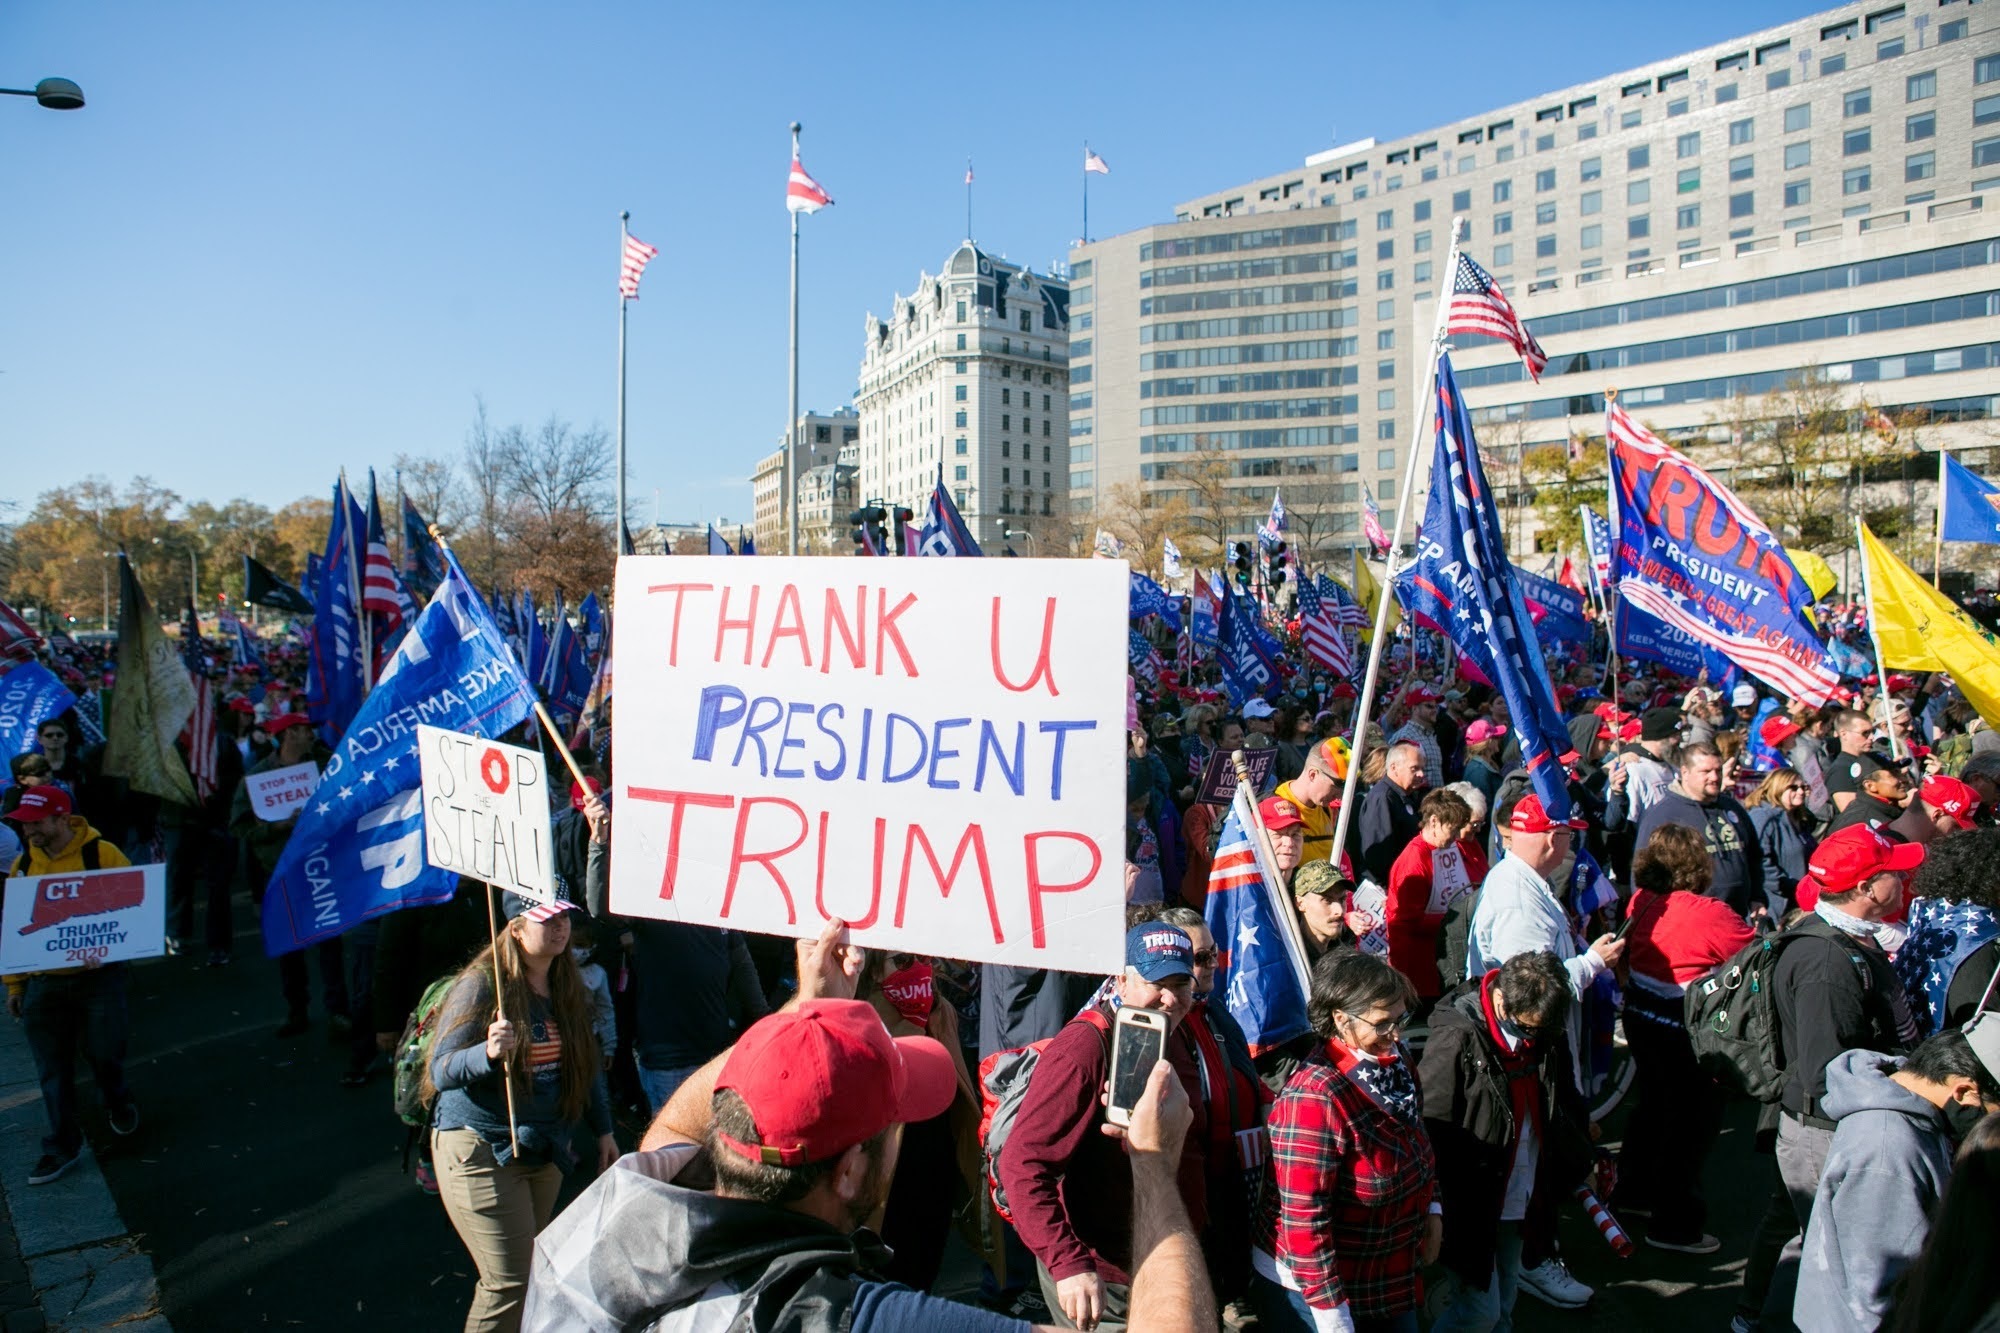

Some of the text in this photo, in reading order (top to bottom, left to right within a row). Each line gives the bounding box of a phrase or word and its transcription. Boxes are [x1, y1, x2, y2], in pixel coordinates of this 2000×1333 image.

[1652, 535, 1768, 606] PRESIDENT
[1523, 581, 1575, 613] UMP
[1620, 542, 1638, 567] AKE
[1706, 595, 1757, 633] GREAT
[1754, 624, 1824, 671] AGAIN!
[648, 583, 919, 677] THANK
[991, 596, 1059, 697] U
[1628, 633, 1655, 645] KEEP
[692, 685, 1098, 801] PRESIDENT
[1223, 757, 1270, 773] P-LIFE
[259, 772, 310, 791] STOP THE
[1220, 772, 1256, 787] VOS
[1942, 799, 1962, 813] 45
[431, 796, 543, 894] STEAL!
[627, 786, 1101, 948] TRUMP
[1439, 851, 1458, 869] OP
[1443, 868, 1459, 884] HE
[46, 880, 84, 900] CT
[57, 920, 120, 939] TRUMP
[46, 931, 129, 952] COUNTRY
[1142, 933, 1191, 950] TRUMP
[66, 946, 109, 962] 2020
[1162, 949, 1182, 957] 2020
[888, 982, 933, 1000] RUM
